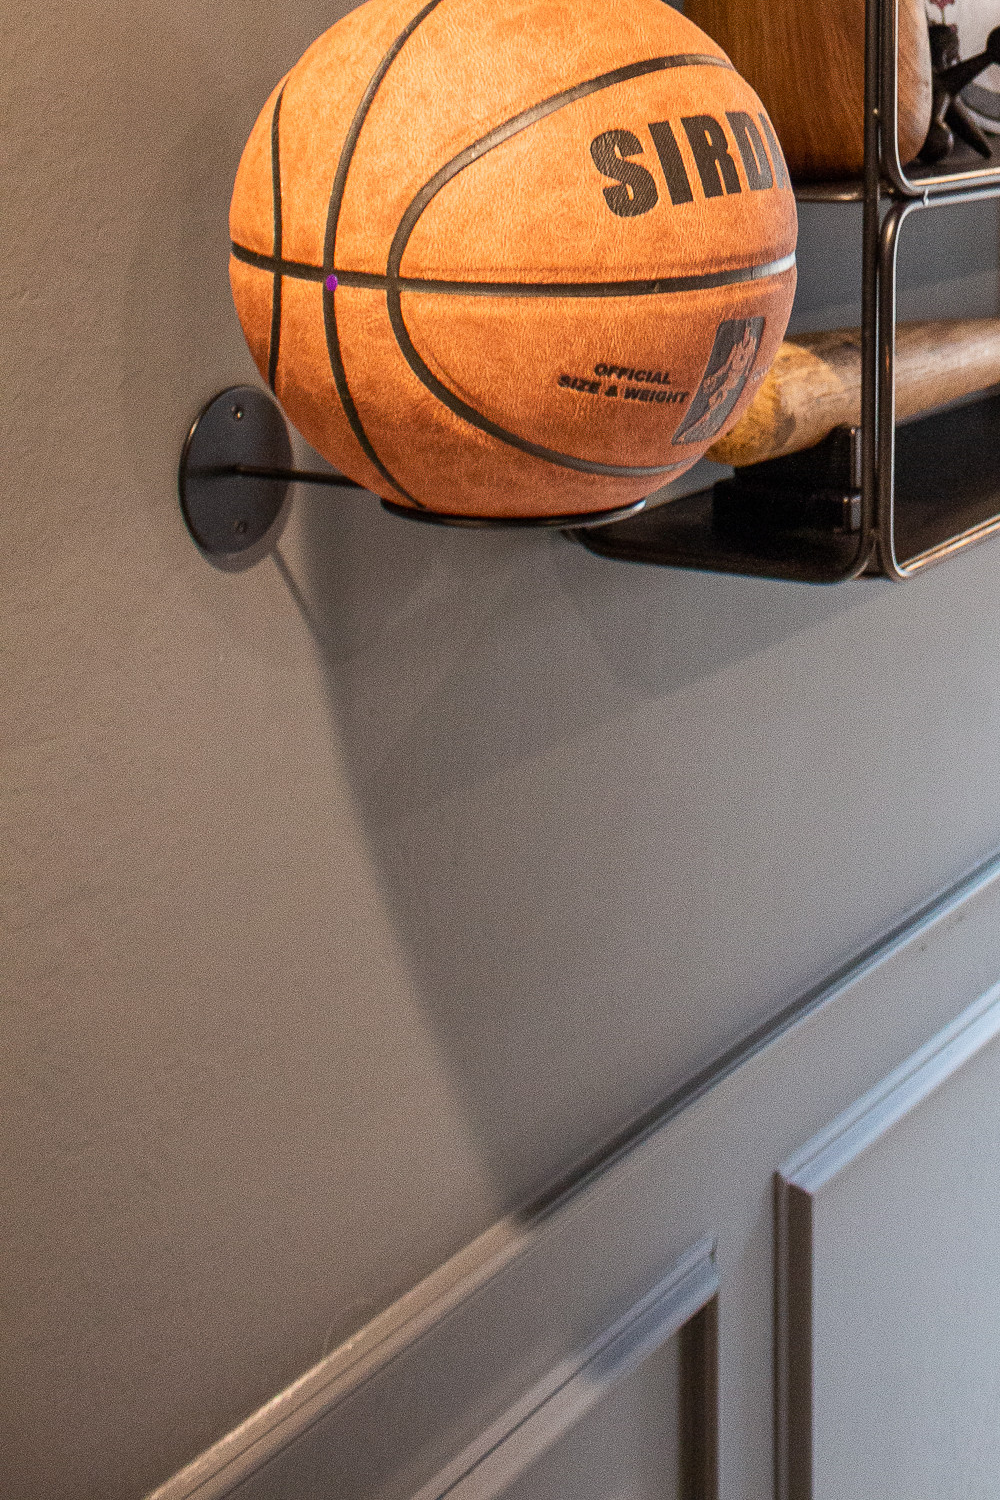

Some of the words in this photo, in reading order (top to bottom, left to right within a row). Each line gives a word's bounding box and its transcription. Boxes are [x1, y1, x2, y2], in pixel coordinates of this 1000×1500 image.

[594, 363, 672, 386] OFFICIAL
[557, 374, 601, 395] SIZE
[623, 387, 691, 405] WEIGHT
